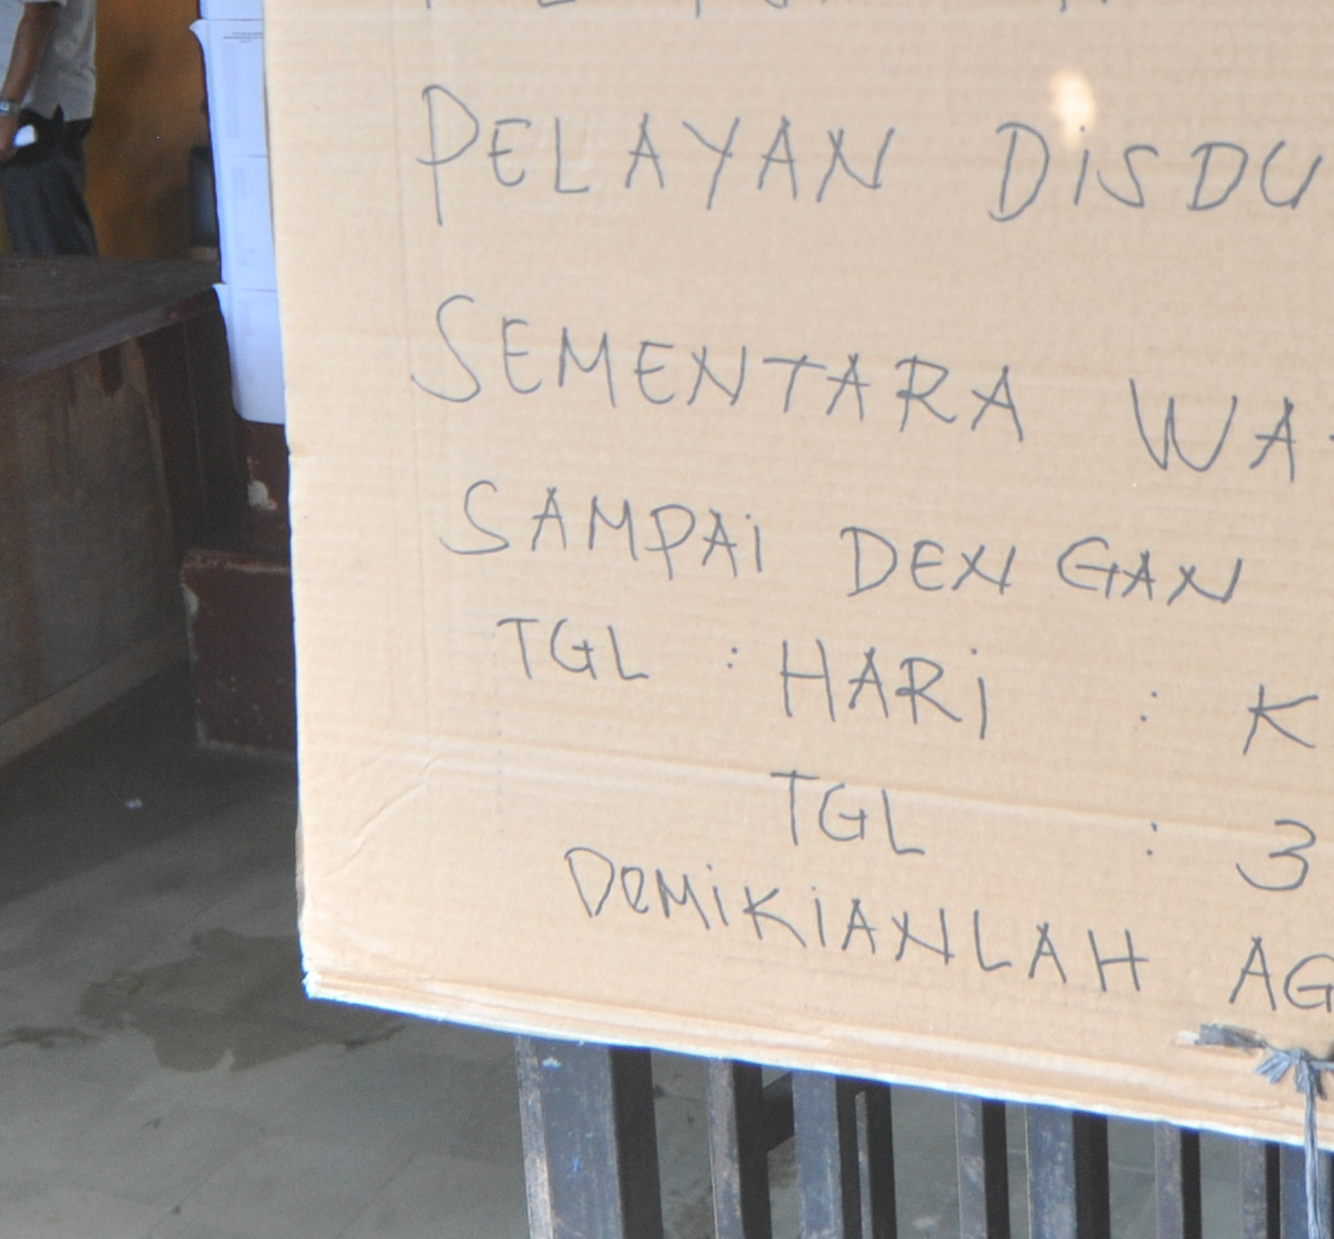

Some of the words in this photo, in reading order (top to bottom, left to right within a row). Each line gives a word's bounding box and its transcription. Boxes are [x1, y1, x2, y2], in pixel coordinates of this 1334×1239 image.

[416, 83, 896, 227] PELAYAN
[409, 293, 1025, 443] SEMENTARA
[495, 616, 651, 682] TGL
[768, 768, 926, 857] TGL
[1234, 817, 1318, 893] 3
